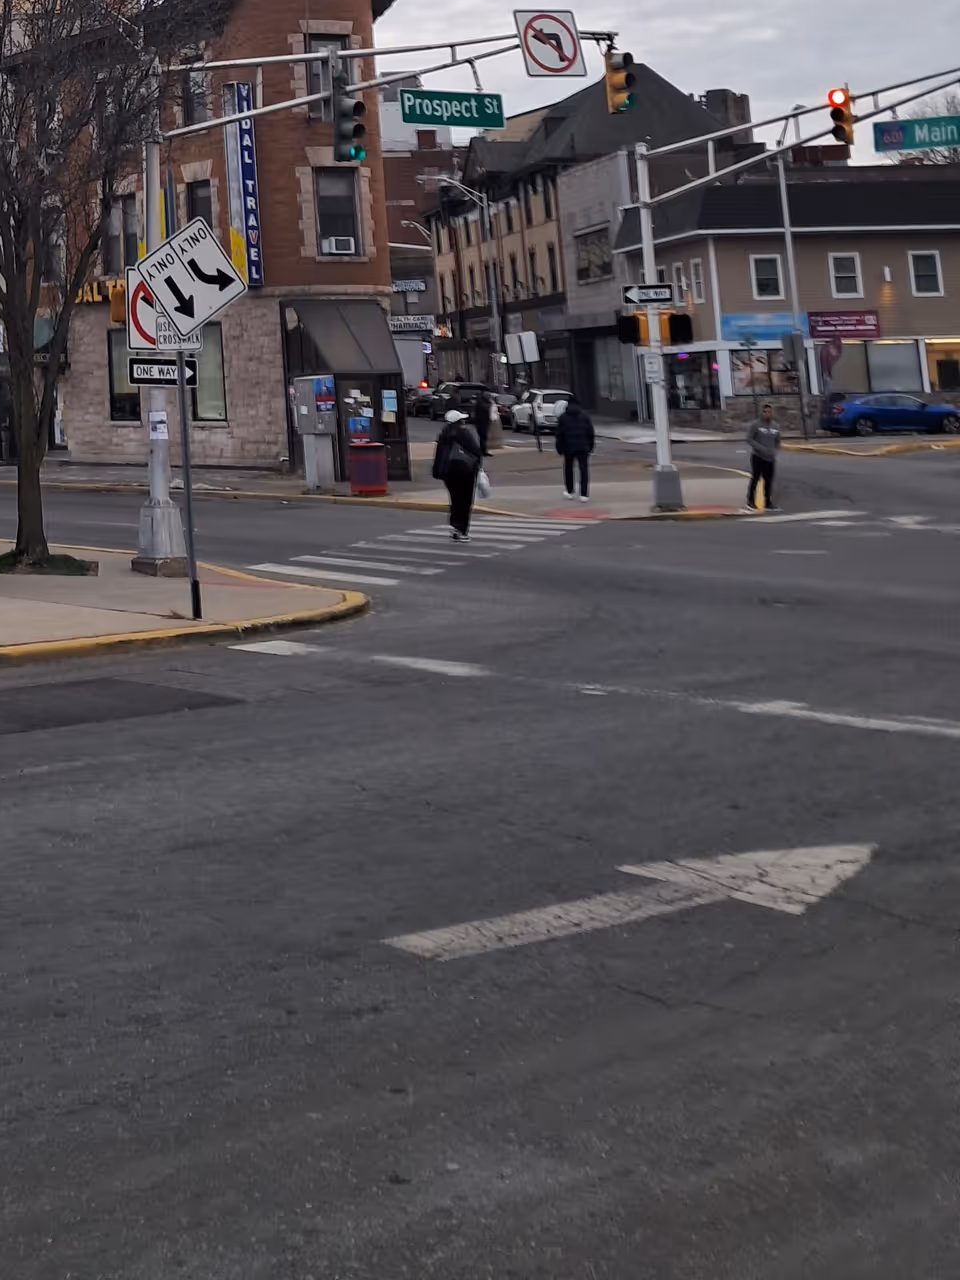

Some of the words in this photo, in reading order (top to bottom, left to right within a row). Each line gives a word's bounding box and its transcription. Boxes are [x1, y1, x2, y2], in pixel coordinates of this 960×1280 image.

[402, 93, 479, 122] Prospect
[484, 97, 500, 114] St
[239, 83, 253, 164] VIDAL
[914, 122, 958, 144] Main
[179, 227, 208, 257] ONLY
[245, 179, 260, 279] TRAVEL
[147, 252, 175, 282] ONLY
[158, 321, 172, 332] USE
[136, 366, 154, 377] ONE
[158, 366, 177, 377] WAY
